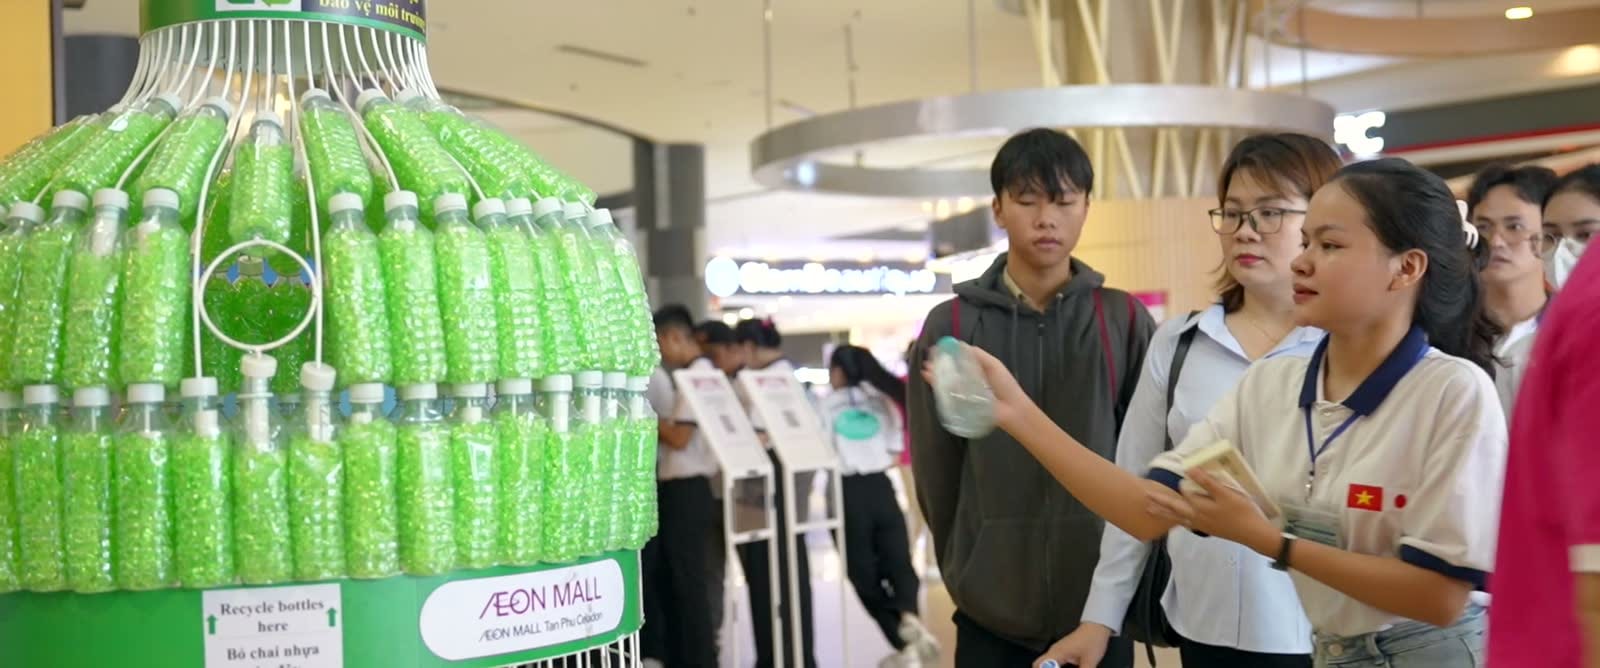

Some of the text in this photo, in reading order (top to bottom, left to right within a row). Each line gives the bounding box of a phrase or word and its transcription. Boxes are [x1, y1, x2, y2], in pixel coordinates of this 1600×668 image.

[375, 3, 399, 19] môi
[553, 576, 602, 608] MALL
[220, 598, 324, 616] Recycle bottles
[258, 621, 288, 632] here
[513, 622, 542, 637] MALL
[544, 620, 559, 632] Tan
[561, 617, 575, 629] Phu
[250, 645, 279, 658] chai
[284, 644, 320, 659] nhựa
